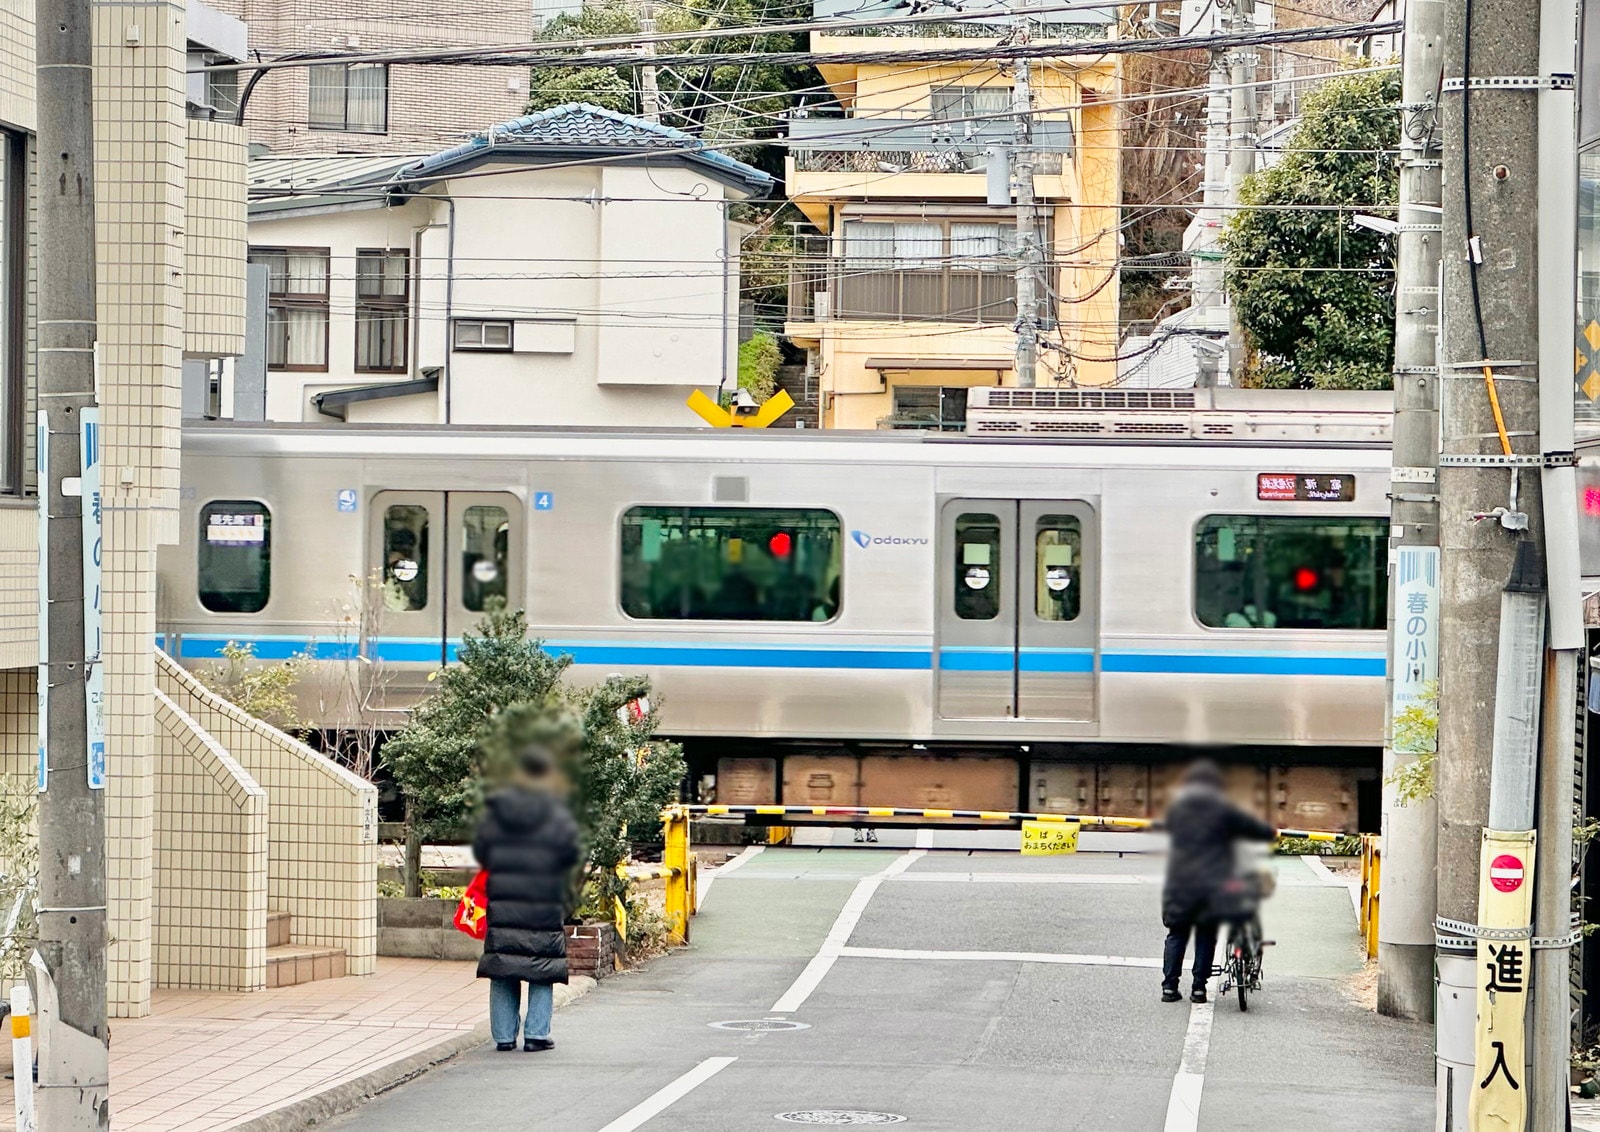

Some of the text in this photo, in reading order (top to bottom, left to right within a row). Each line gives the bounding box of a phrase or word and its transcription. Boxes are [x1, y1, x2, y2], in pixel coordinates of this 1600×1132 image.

[538, 494, 549, 508] 4
[873, 535, 928, 545] odakyu
[1405, 591, 1428, 684] 春の小川
[1024, 830, 1077, 840] しばらく
[1024, 842, 1075, 851] おまちください
[1479, 943, 1524, 1091] 進入
